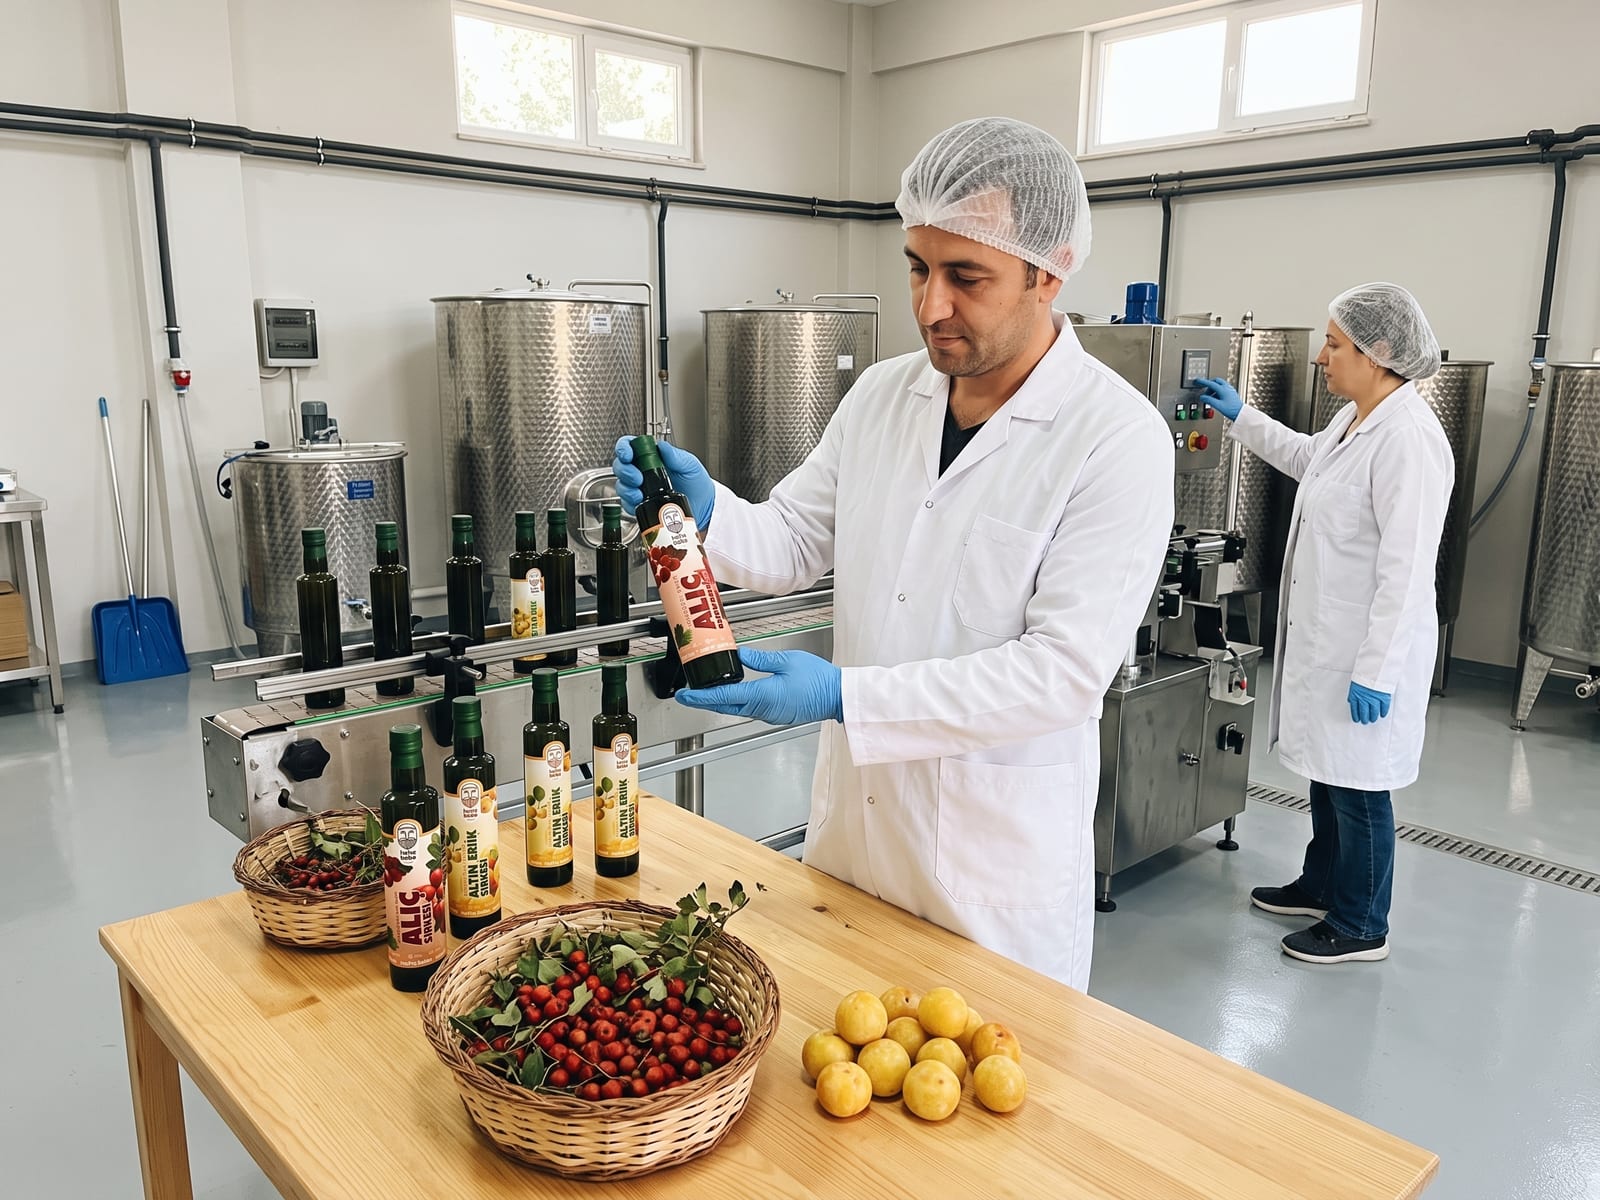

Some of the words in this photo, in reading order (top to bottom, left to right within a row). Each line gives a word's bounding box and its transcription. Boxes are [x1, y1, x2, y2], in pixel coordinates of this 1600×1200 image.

[553, 818, 562, 848] ALTIN
[619, 808, 629, 839] ALTIN
[469, 864, 479, 898] ALTIN
[399, 891, 426, 946] ALIÇ
